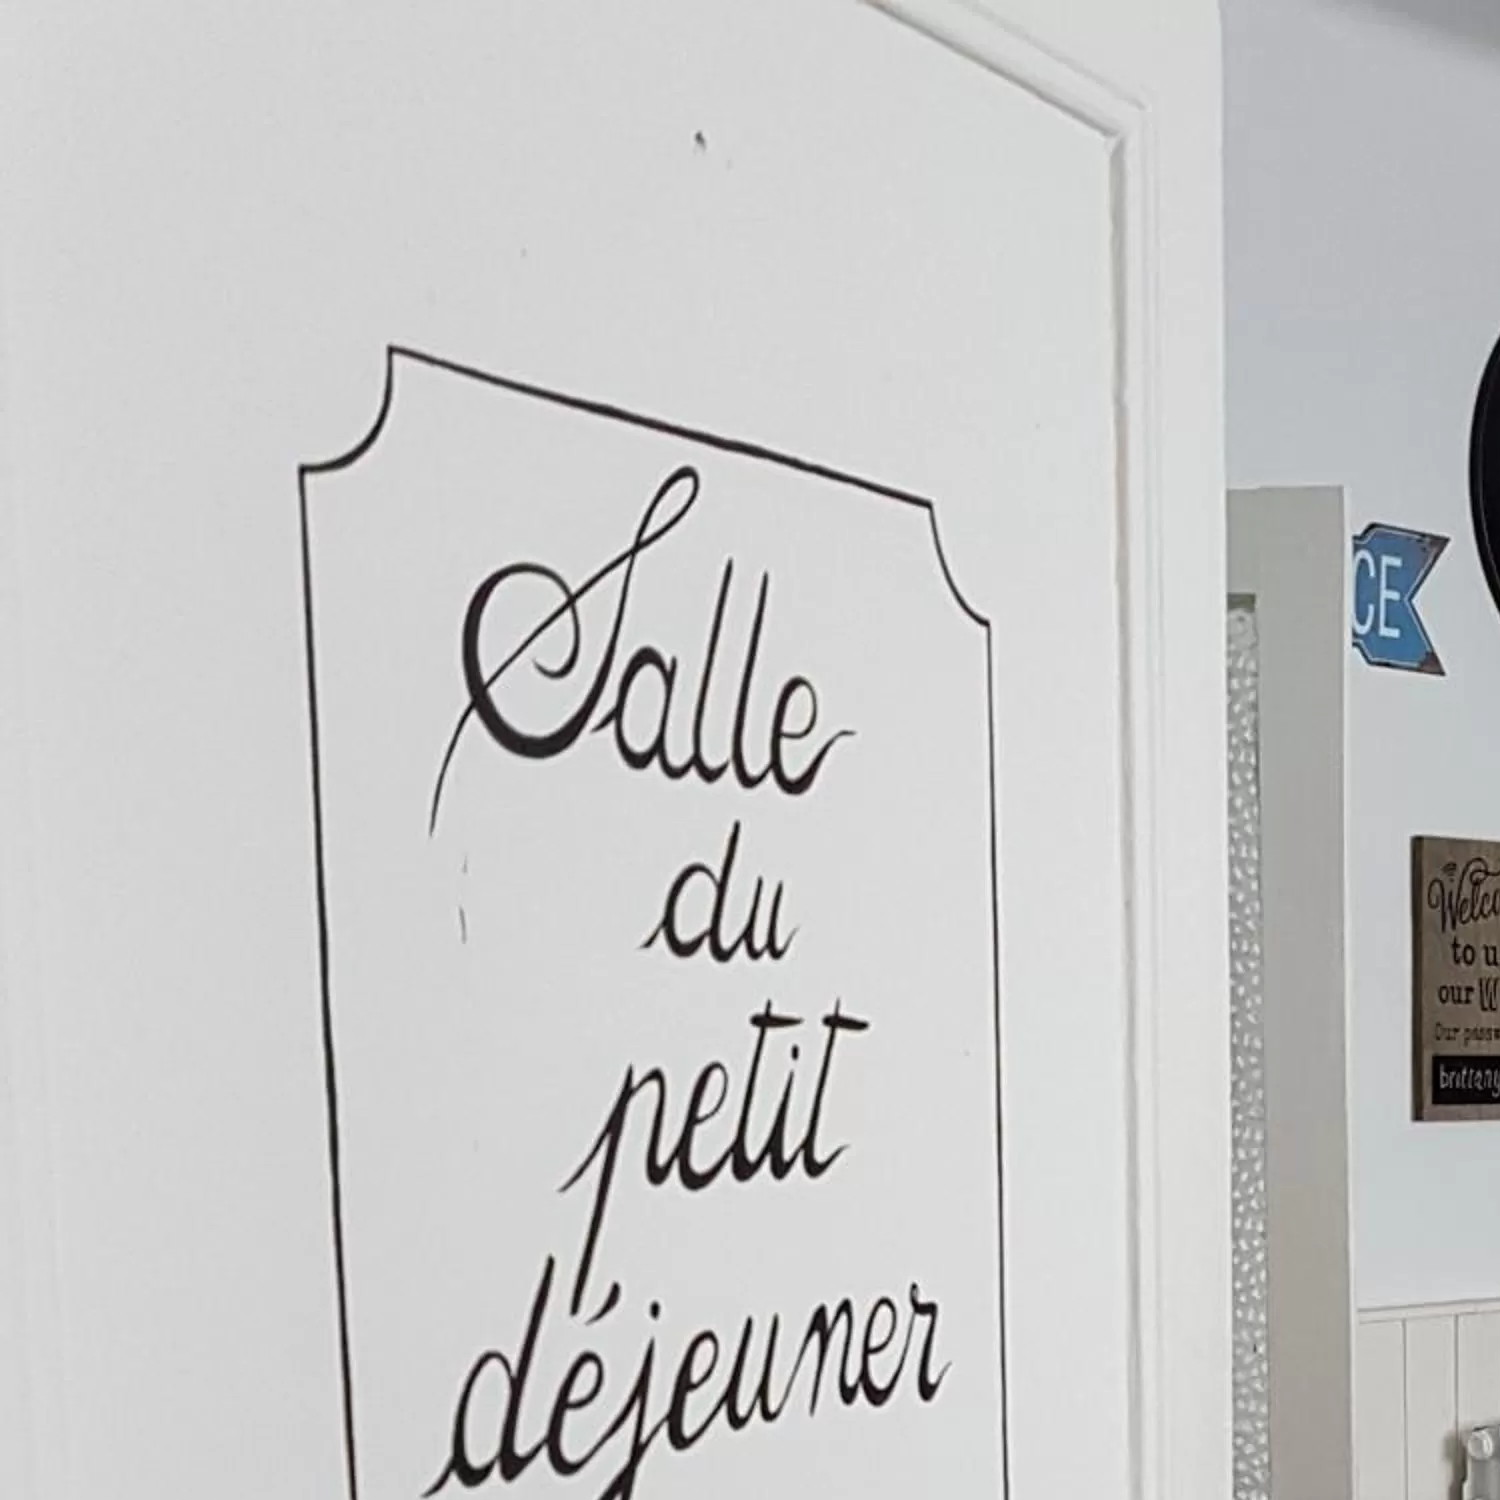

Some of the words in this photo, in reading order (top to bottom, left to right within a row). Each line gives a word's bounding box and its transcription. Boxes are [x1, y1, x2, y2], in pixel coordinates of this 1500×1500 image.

[430, 466, 856, 837] Salle
[640, 820, 798, 963] du
[1437, 982, 1475, 1006] our
[1451, 937, 1476, 967] to
[1435, 1021, 1461, 1041] Our
[559, 997, 870, 1317] petit
